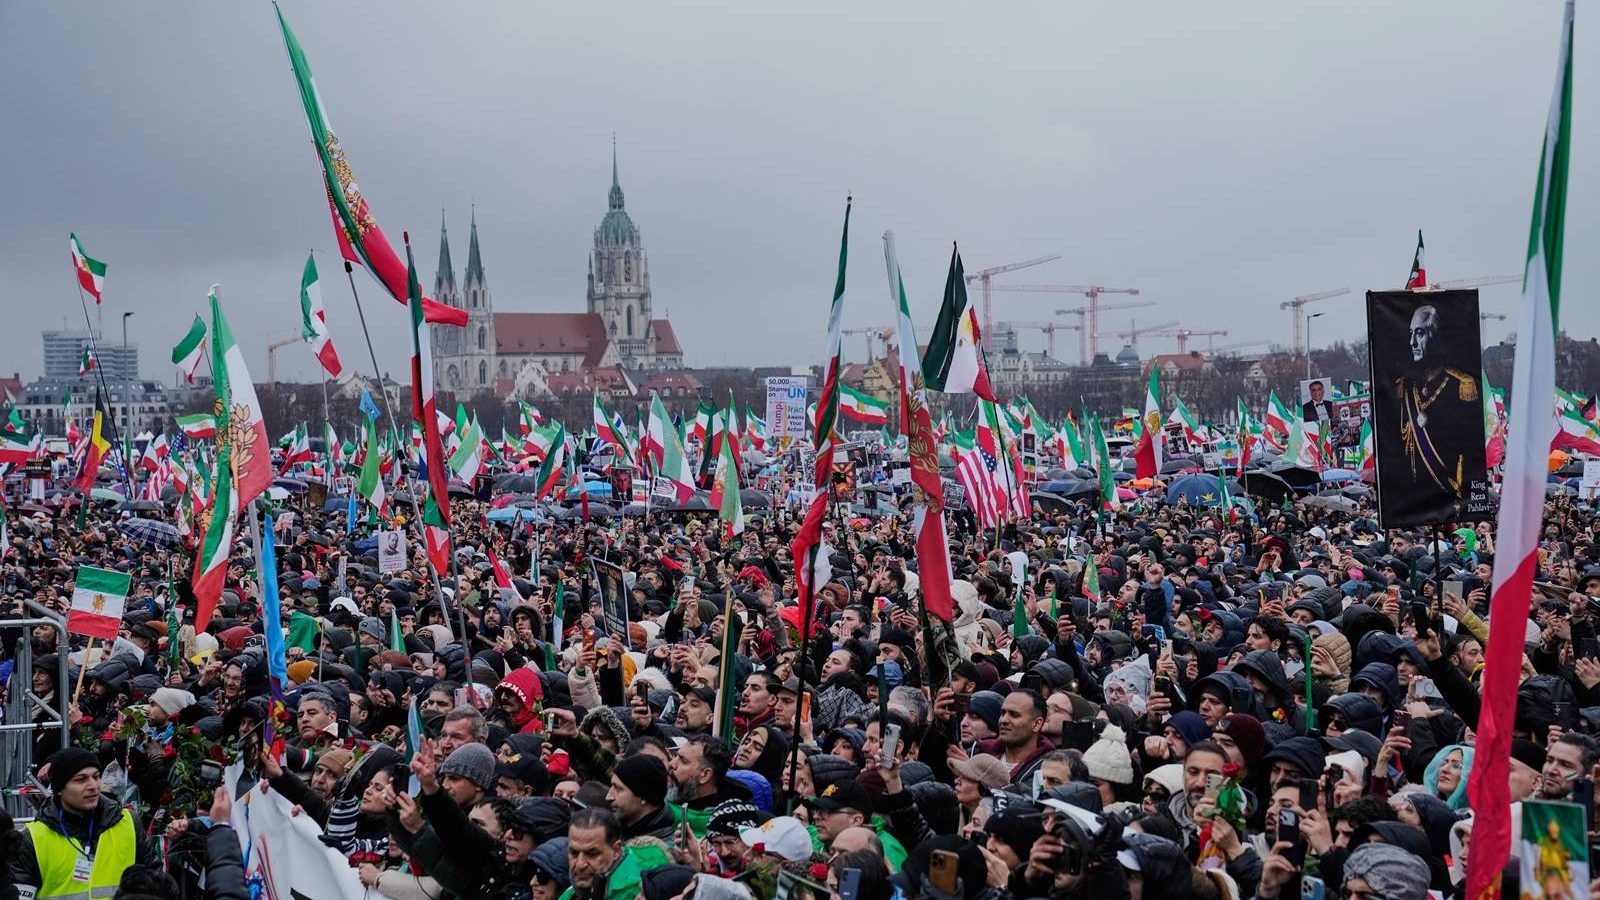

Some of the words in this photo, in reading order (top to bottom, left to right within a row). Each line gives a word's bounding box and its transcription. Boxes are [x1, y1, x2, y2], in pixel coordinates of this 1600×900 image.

[787, 387, 806, 398] UN
[787, 405, 804, 413] Iran
[774, 404, 784, 432] Trump
[1471, 480, 1486, 490] King
[1470, 492, 1486, 500] Reza
[1467, 502, 1490, 512] Pahlavi
